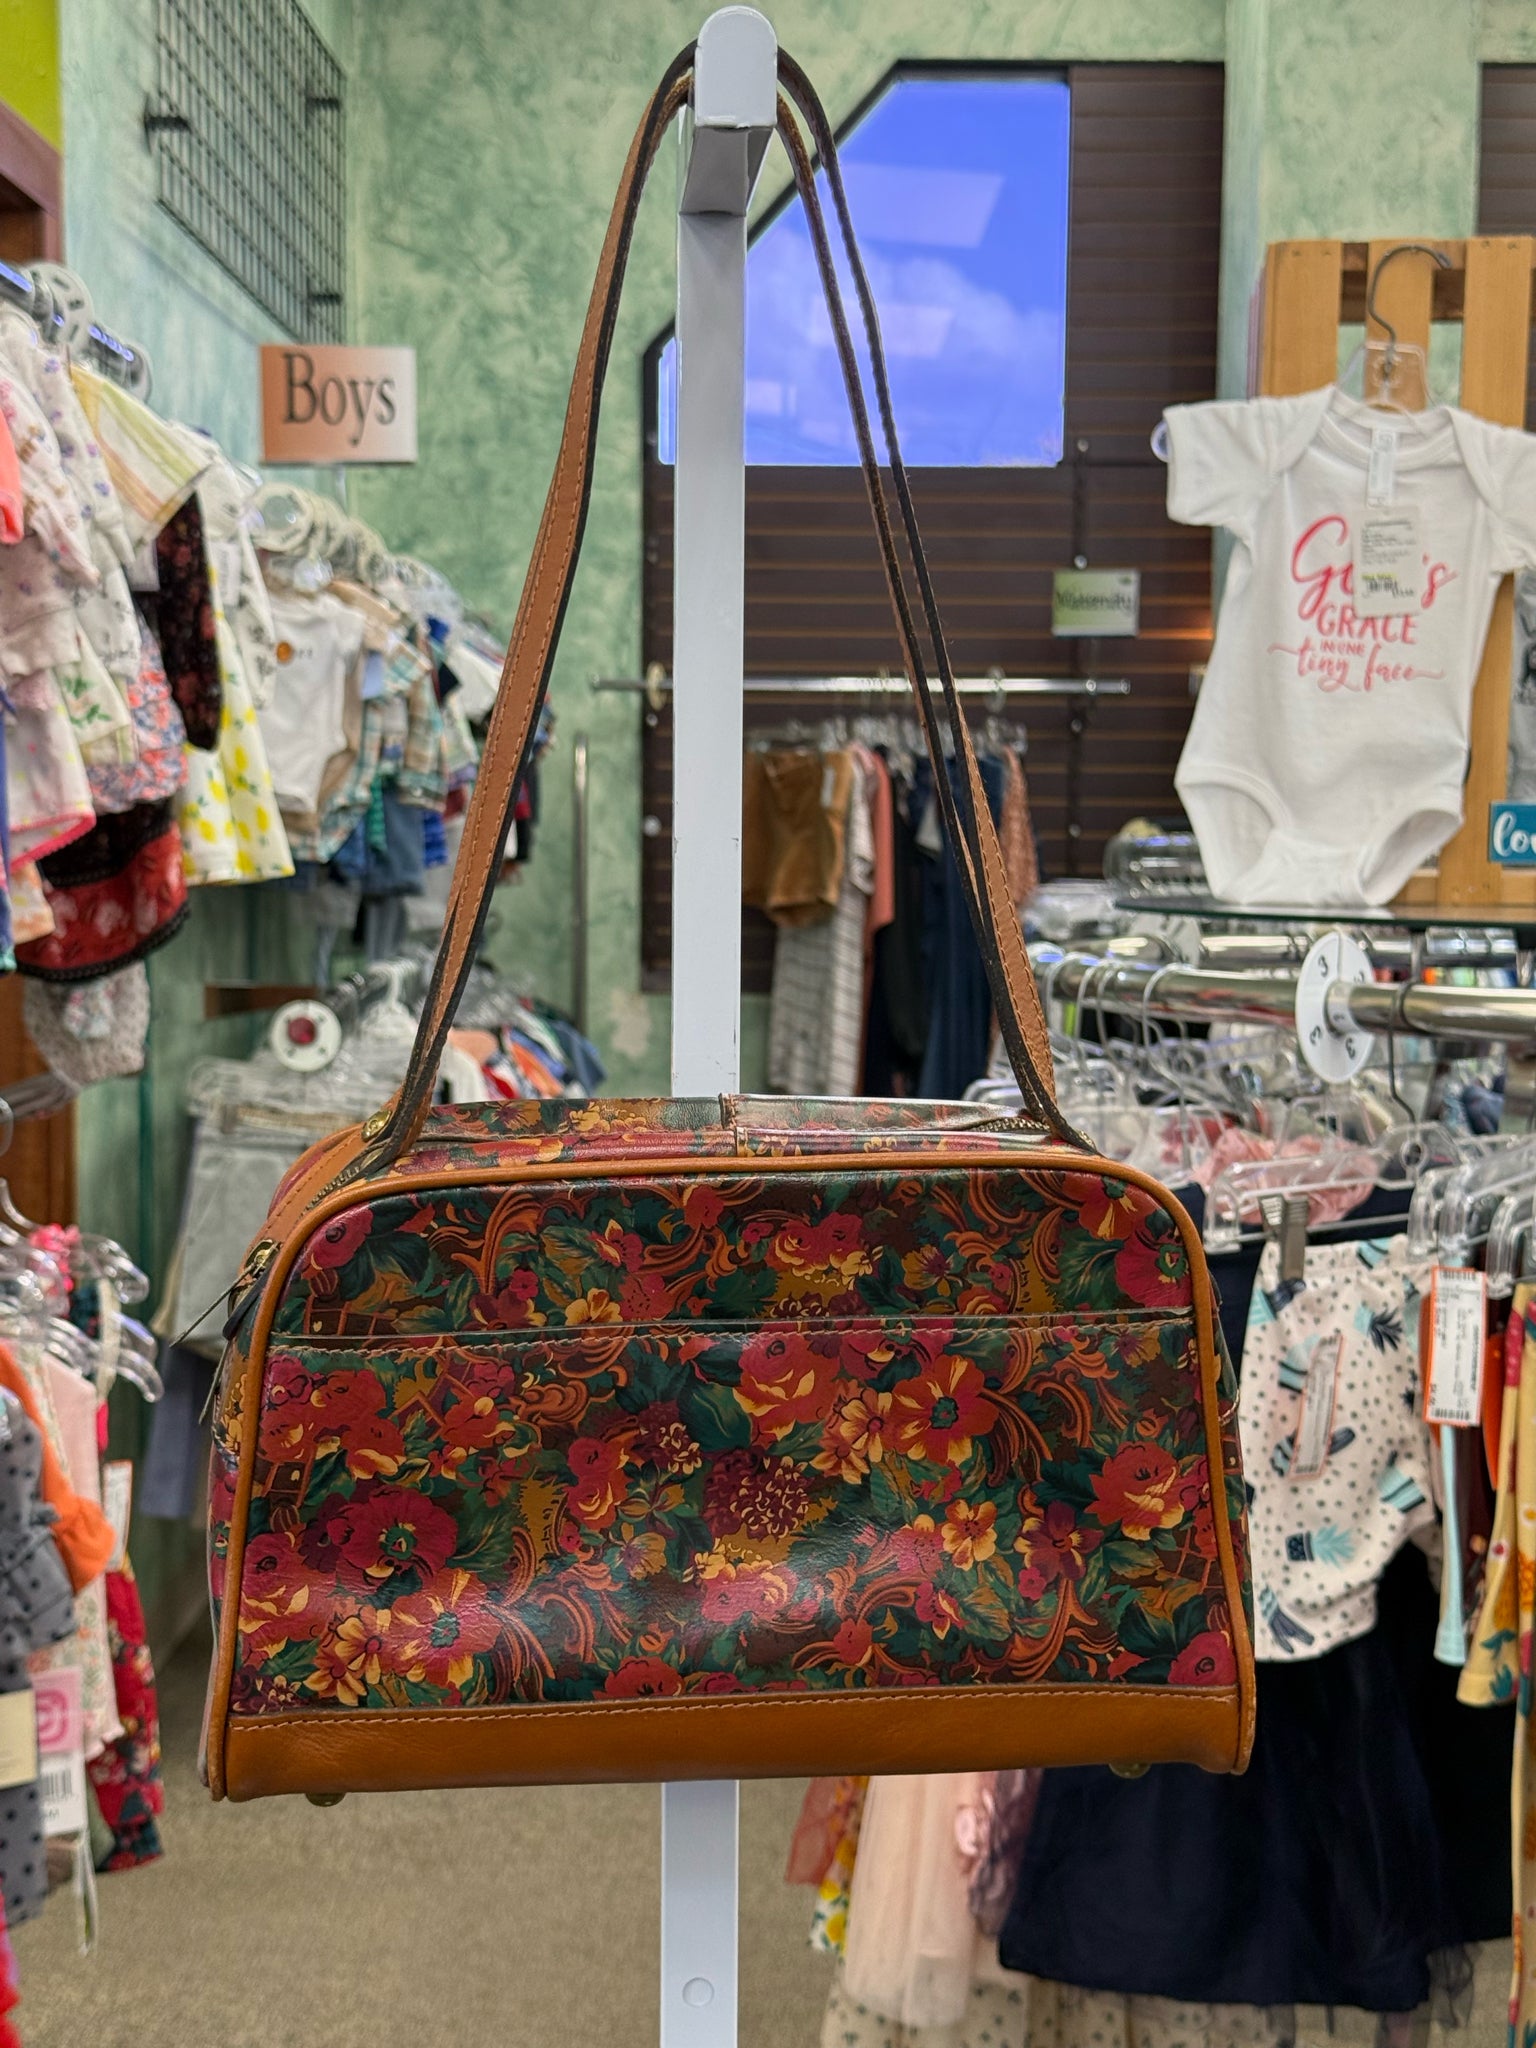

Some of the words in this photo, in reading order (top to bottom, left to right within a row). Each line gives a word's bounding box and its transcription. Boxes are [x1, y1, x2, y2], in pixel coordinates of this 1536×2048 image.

[283, 352, 396, 447] Boys
[1317, 604, 1416, 644] GRACE
[1270, 638, 1360, 692] tiny
[1364, 644, 1443, 691] face
